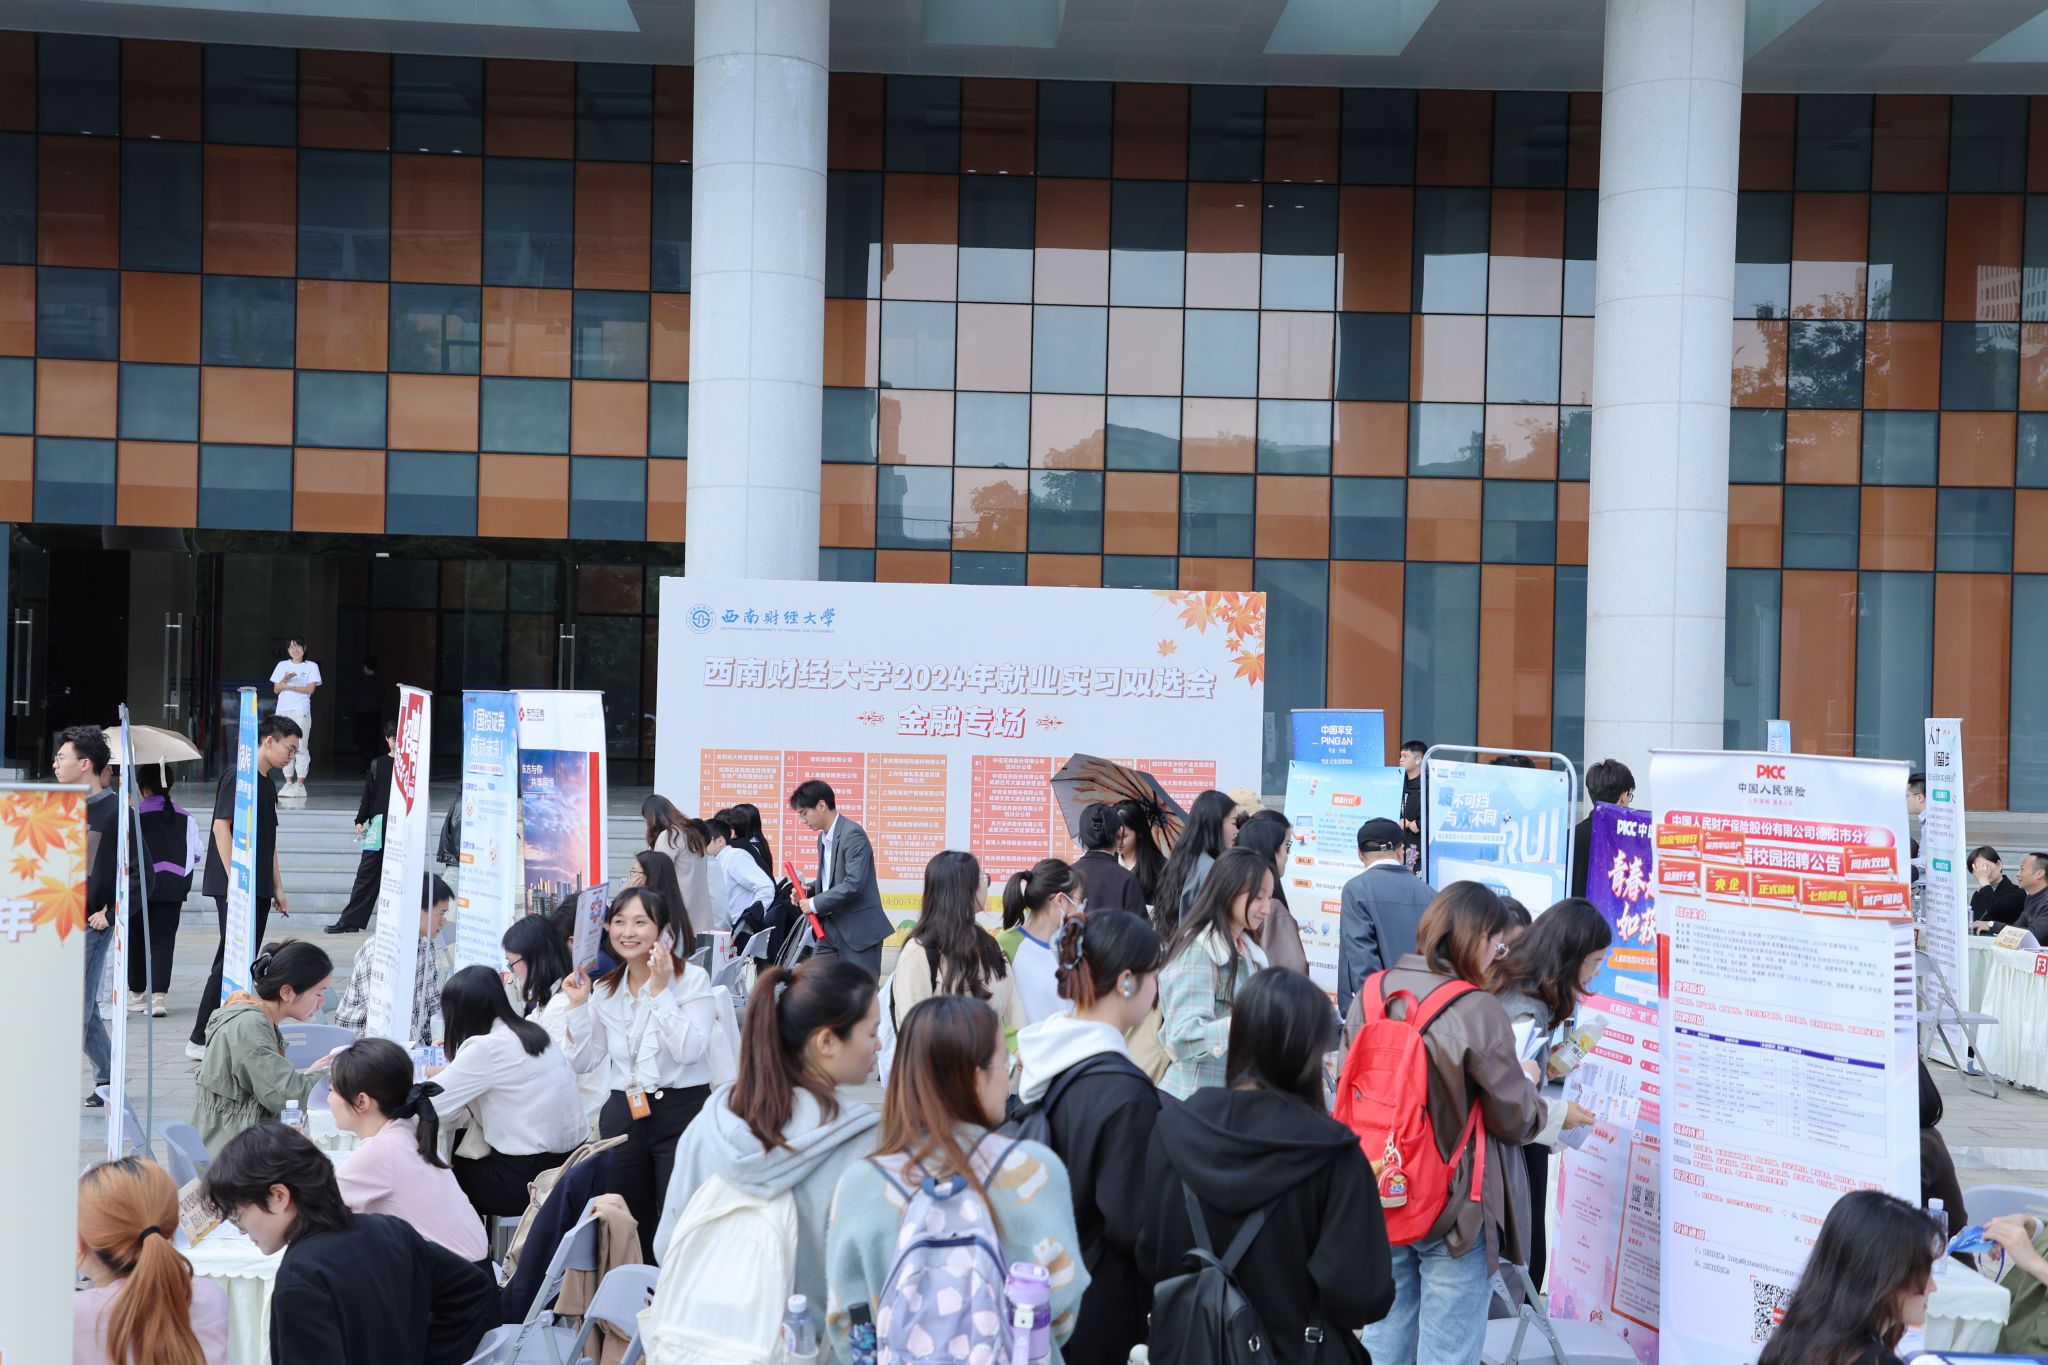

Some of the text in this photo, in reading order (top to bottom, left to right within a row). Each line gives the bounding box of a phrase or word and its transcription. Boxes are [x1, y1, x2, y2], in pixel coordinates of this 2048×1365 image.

[703, 655, 1216, 700] 西南财经大学2024年就业实习双选会
[897, 703, 1027, 739] 金融专场
[1321, 725, 1353, 735] 中国平安
[1756, 764, 1785, 780] PICC
[1738, 782, 1806, 797] 中国人民保险
[1445, 808, 1497, 830] 与众不同
[1617, 819, 1636, 836] PICC
[1659, 834, 1697, 845] 法定节假日
[1851, 857, 1890, 870] 周末双休
[1663, 870, 1696, 881] 金融行业
[1758, 883, 1795, 895] 正式编制
[1808, 891, 1848, 902] 七险两金
[1862, 893, 1903, 906] 财产保险
[2037, 957, 2047, 973] F3
